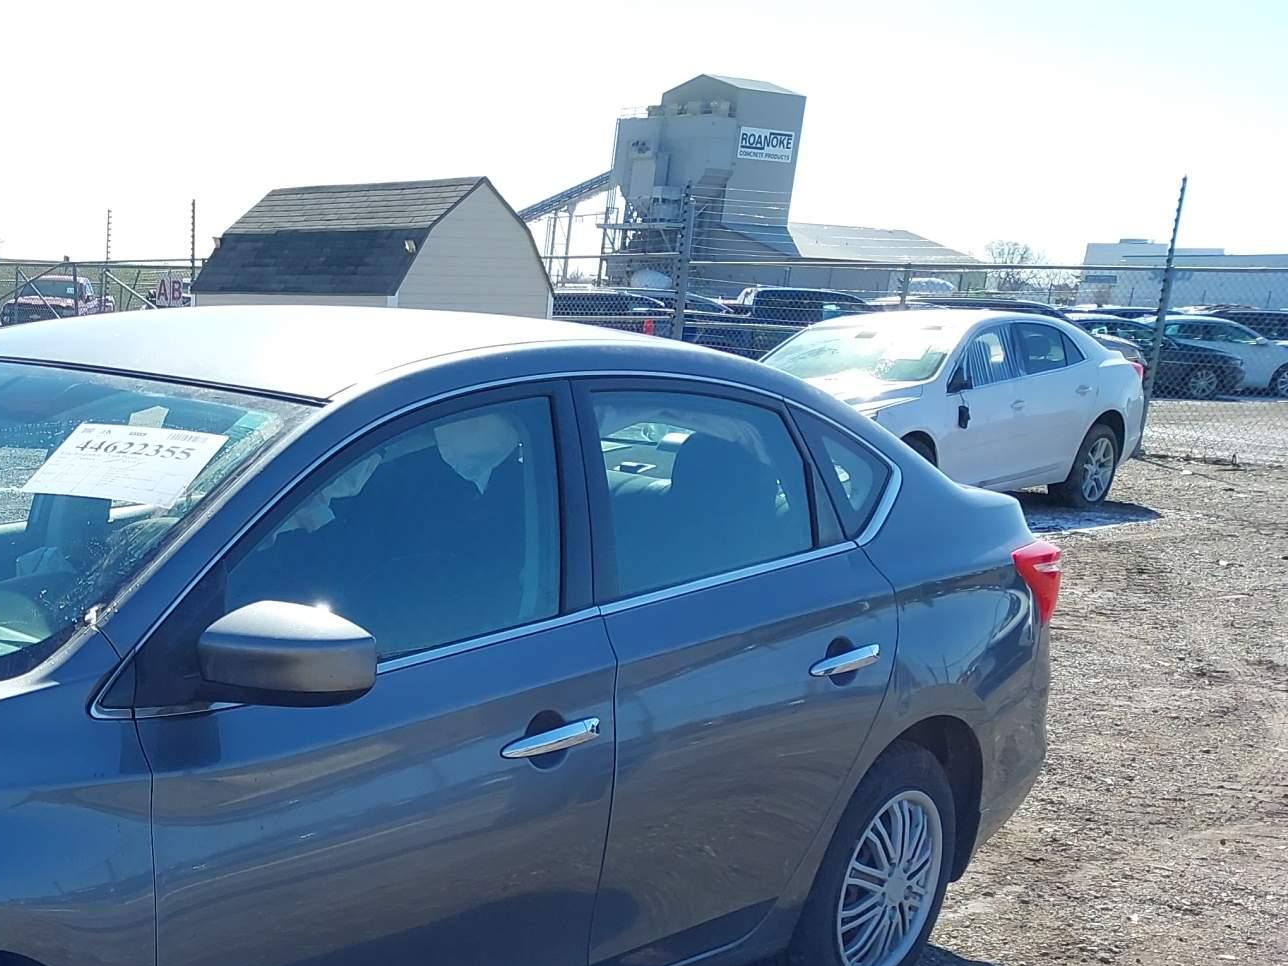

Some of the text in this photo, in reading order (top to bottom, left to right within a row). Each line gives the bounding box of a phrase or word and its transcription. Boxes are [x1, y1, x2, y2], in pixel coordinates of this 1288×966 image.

[740, 132, 793, 150] ROANOKE
[739, 150, 790, 161] CONCRETE PRODUCTS
[75, 440, 196, 461] 44622355
